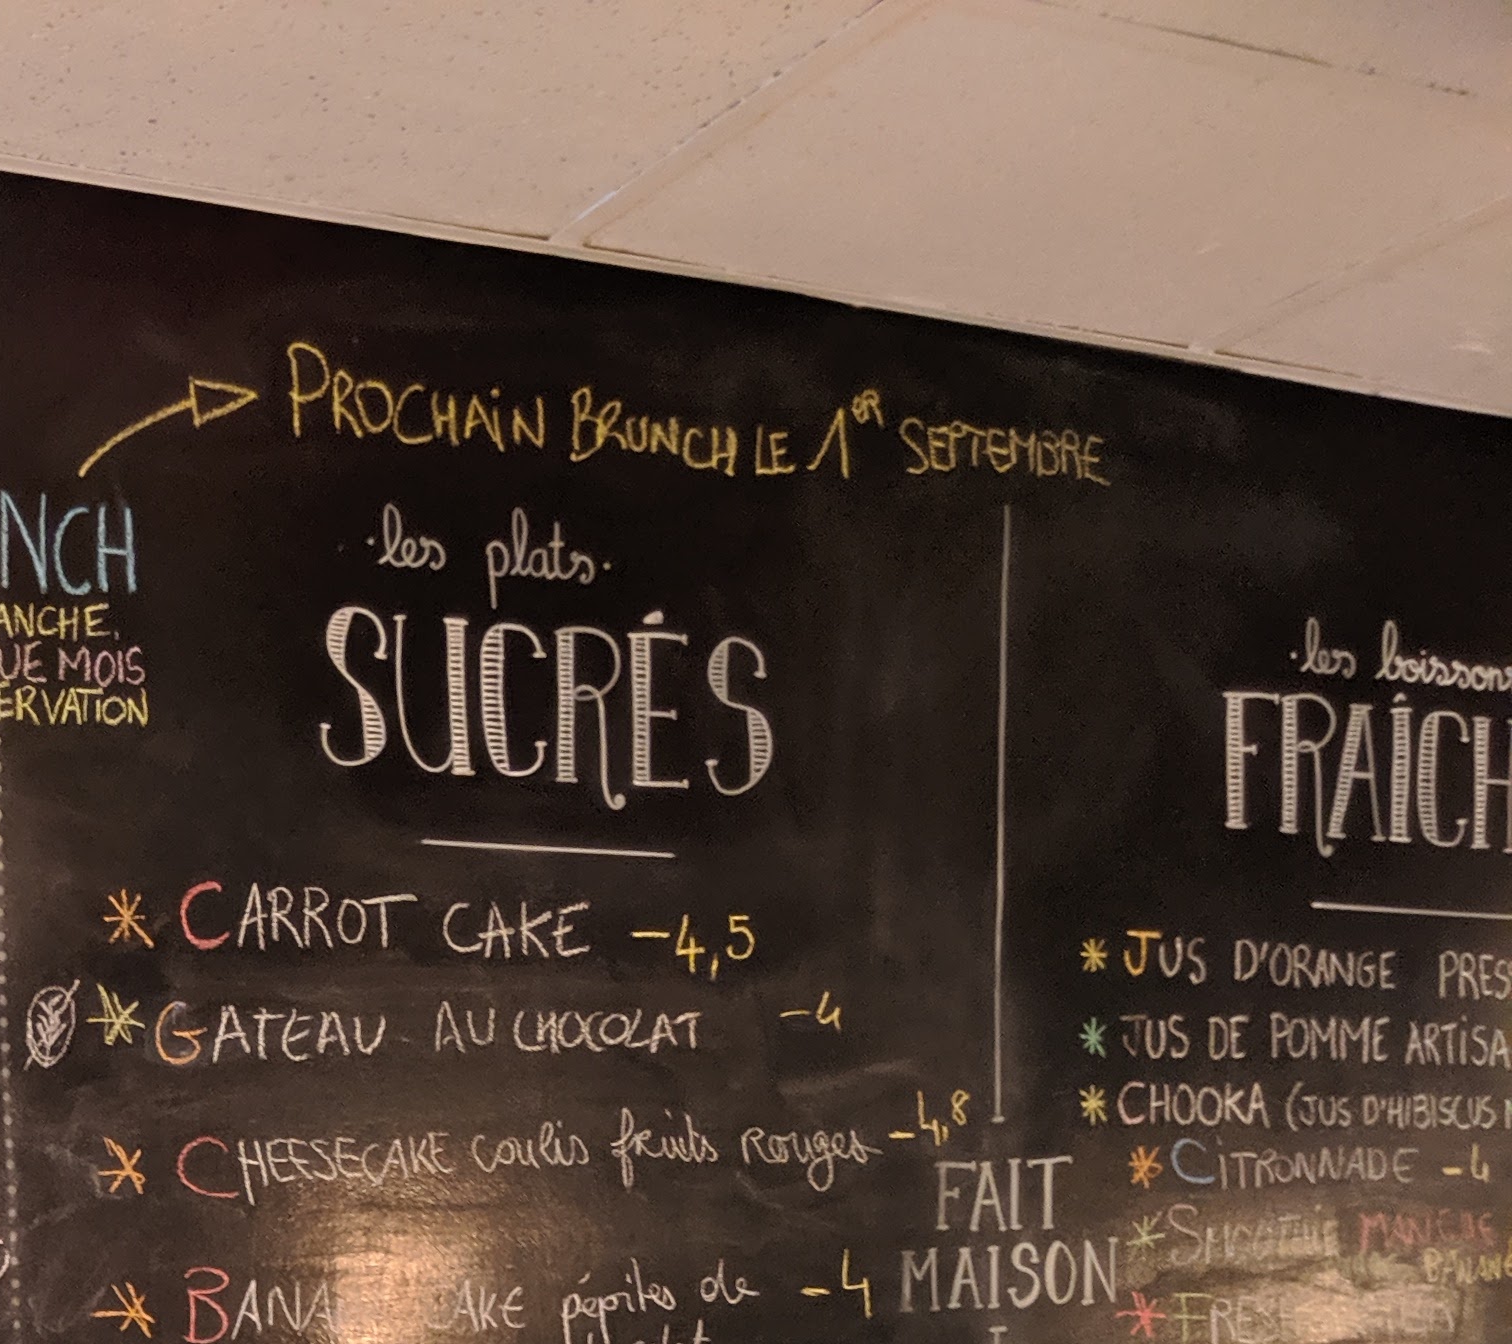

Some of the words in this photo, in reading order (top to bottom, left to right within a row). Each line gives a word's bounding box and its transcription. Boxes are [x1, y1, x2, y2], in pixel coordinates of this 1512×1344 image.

[288, 342, 544, 452] PROCHAIN
[898, 417, 1110, 485] SEPTEMBRE
[376, 504, 446, 571] les
[57, 645, 147, 689] MOIS
[320, 607, 774, 810] SUCRÉS
[1223, 690, 1512, 858] FRAÎCH
[180, 880, 418, 950] CARROT
[443, 901, 590, 959] CAKE
[1123, 929, 1207, 985] JUS
[1234, 938, 1397, 990] D'ORANGE
[155, 1001, 386, 1066] GATEAU
[436, 1001, 494, 1053] AU
[513, 1008, 702, 1054] CHOCOLAT
[1120, 1014, 1190, 1060] JUS
[1207, 1015, 1250, 1060] DE
[1269, 1012, 1391, 1064] POMME
[1404, 1014, 1512, 1070] ARTISA
[1118, 1081, 1271, 1128] CHOOKA
[177, 1131, 453, 1206] CHEESECAKE
[935, 1156, 1074, 1232] FAIT
[1170, 1136, 1419, 1190] CITRONNADE
[899, 1236, 1119, 1313] MAISON
